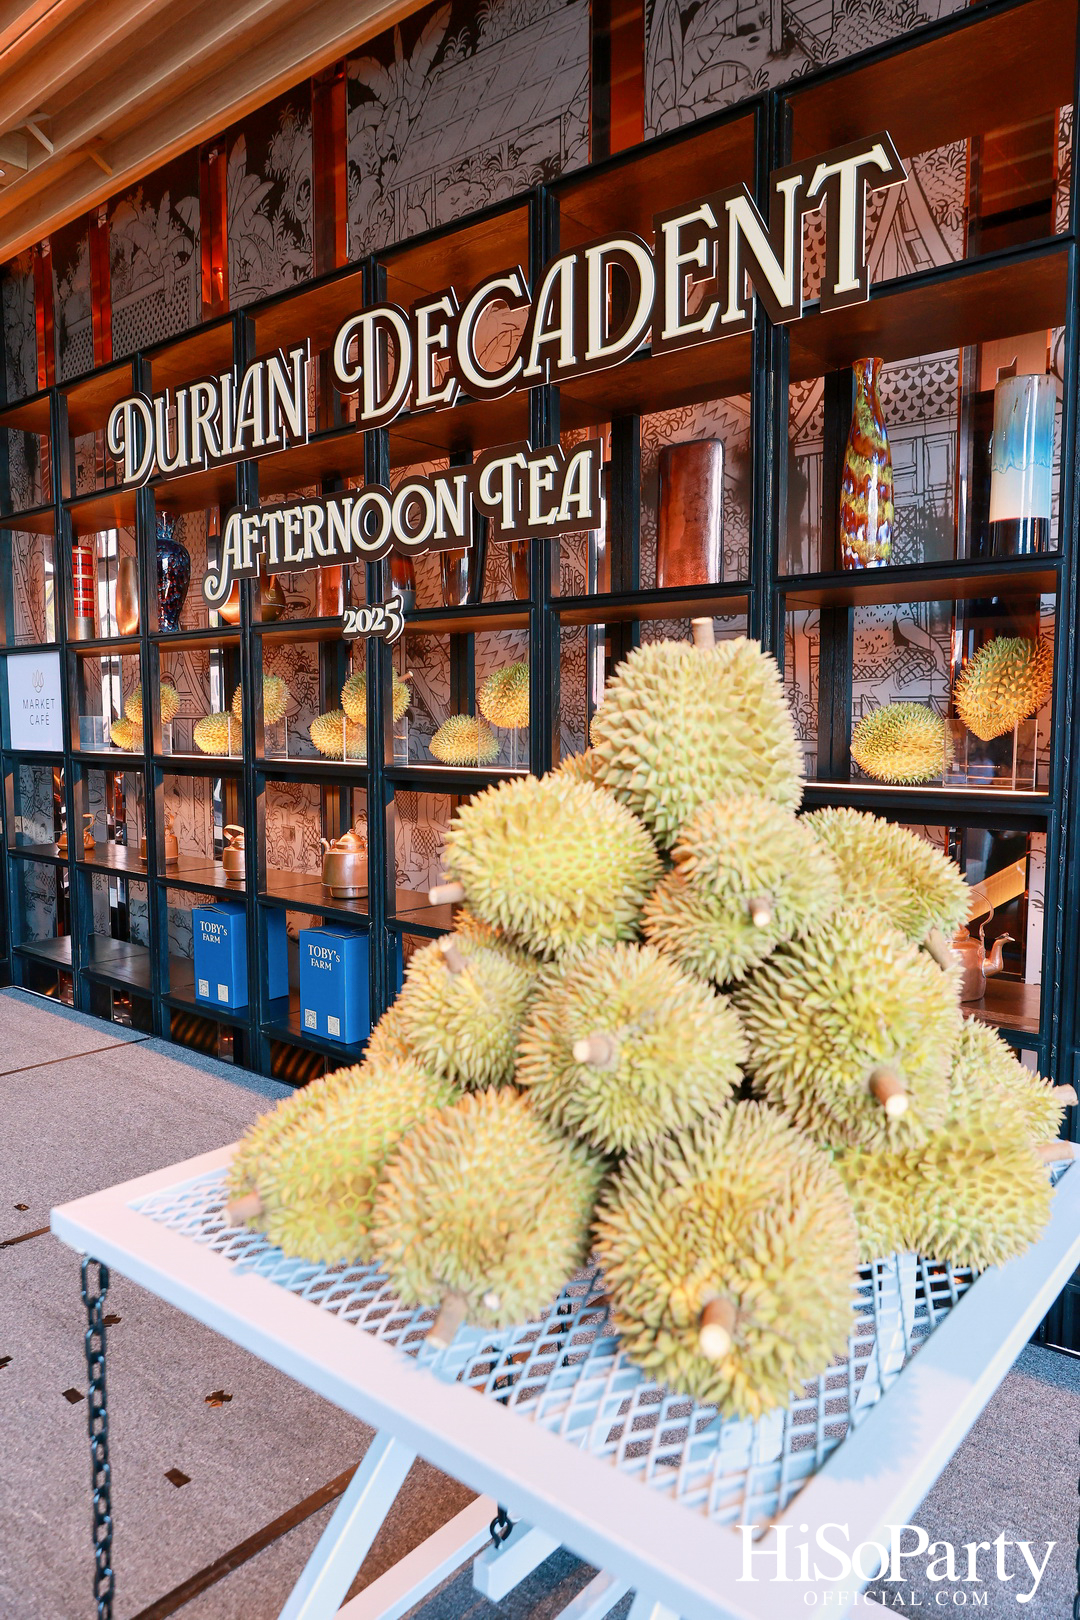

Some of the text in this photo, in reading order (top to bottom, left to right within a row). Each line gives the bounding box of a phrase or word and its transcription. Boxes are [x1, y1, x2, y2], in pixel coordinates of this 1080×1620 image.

[107, 143, 893, 484] DURIAN DECADENT
[206, 449, 593, 601] AFTERNOON TEA
[342, 603, 403, 640] 2025
[22, 698, 55, 710] MARKET
[29, 712, 50, 726] CAFÉ
[200, 920, 228, 937] TOBY's
[202, 933, 221, 944] FARM
[307, 944, 341, 963] TOBY's
[310, 958, 332, 971] FARM
